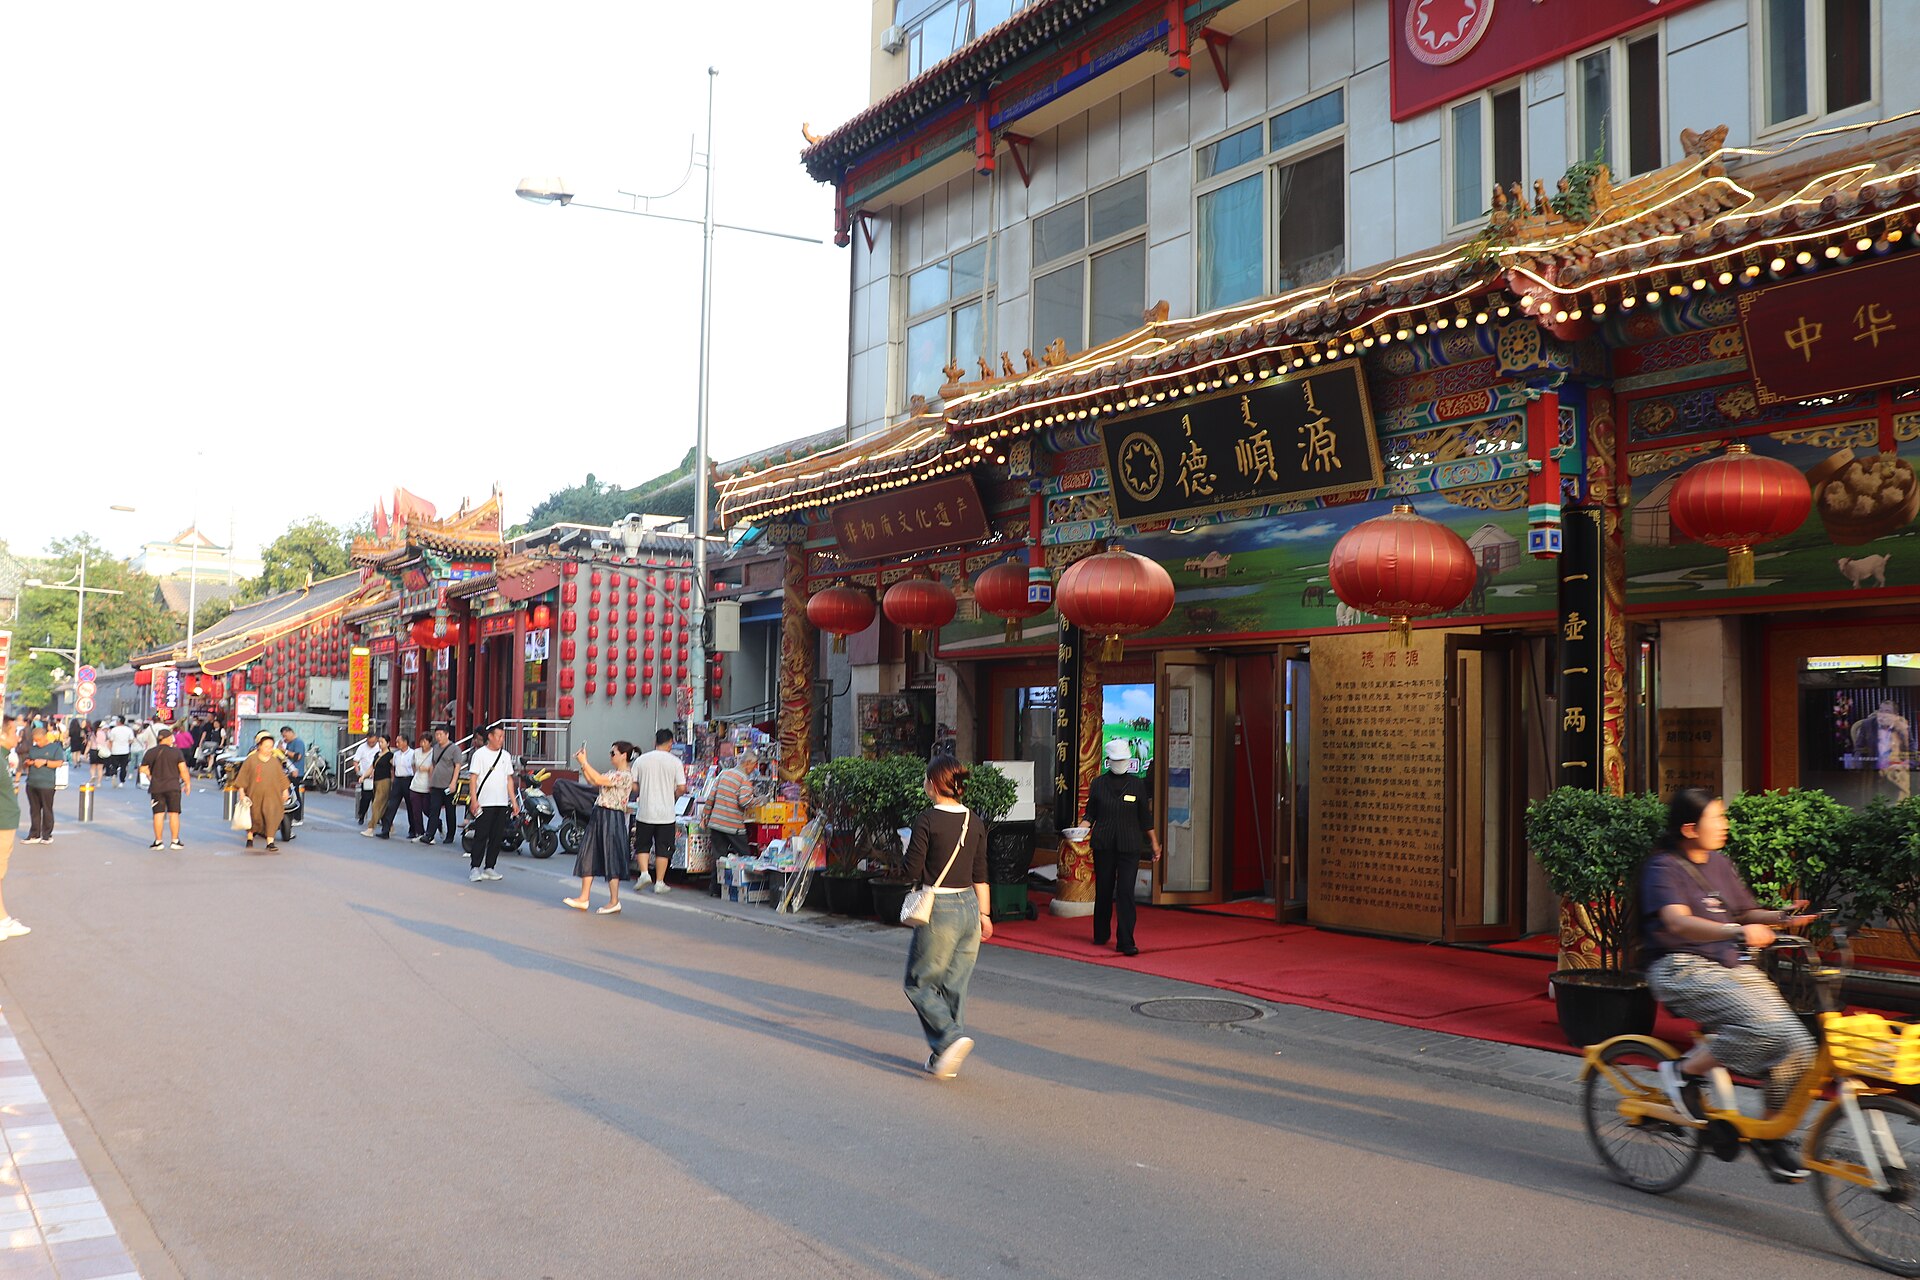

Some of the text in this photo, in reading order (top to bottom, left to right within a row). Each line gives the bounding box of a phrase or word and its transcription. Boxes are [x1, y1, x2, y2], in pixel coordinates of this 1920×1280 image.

[1784, 303, 1896, 362] 中华
[1175, 417, 1342, 499] 德順源
[845, 498, 967, 544] 非物质文化遗产
[1361, 650, 1420, 668] 德顺源
